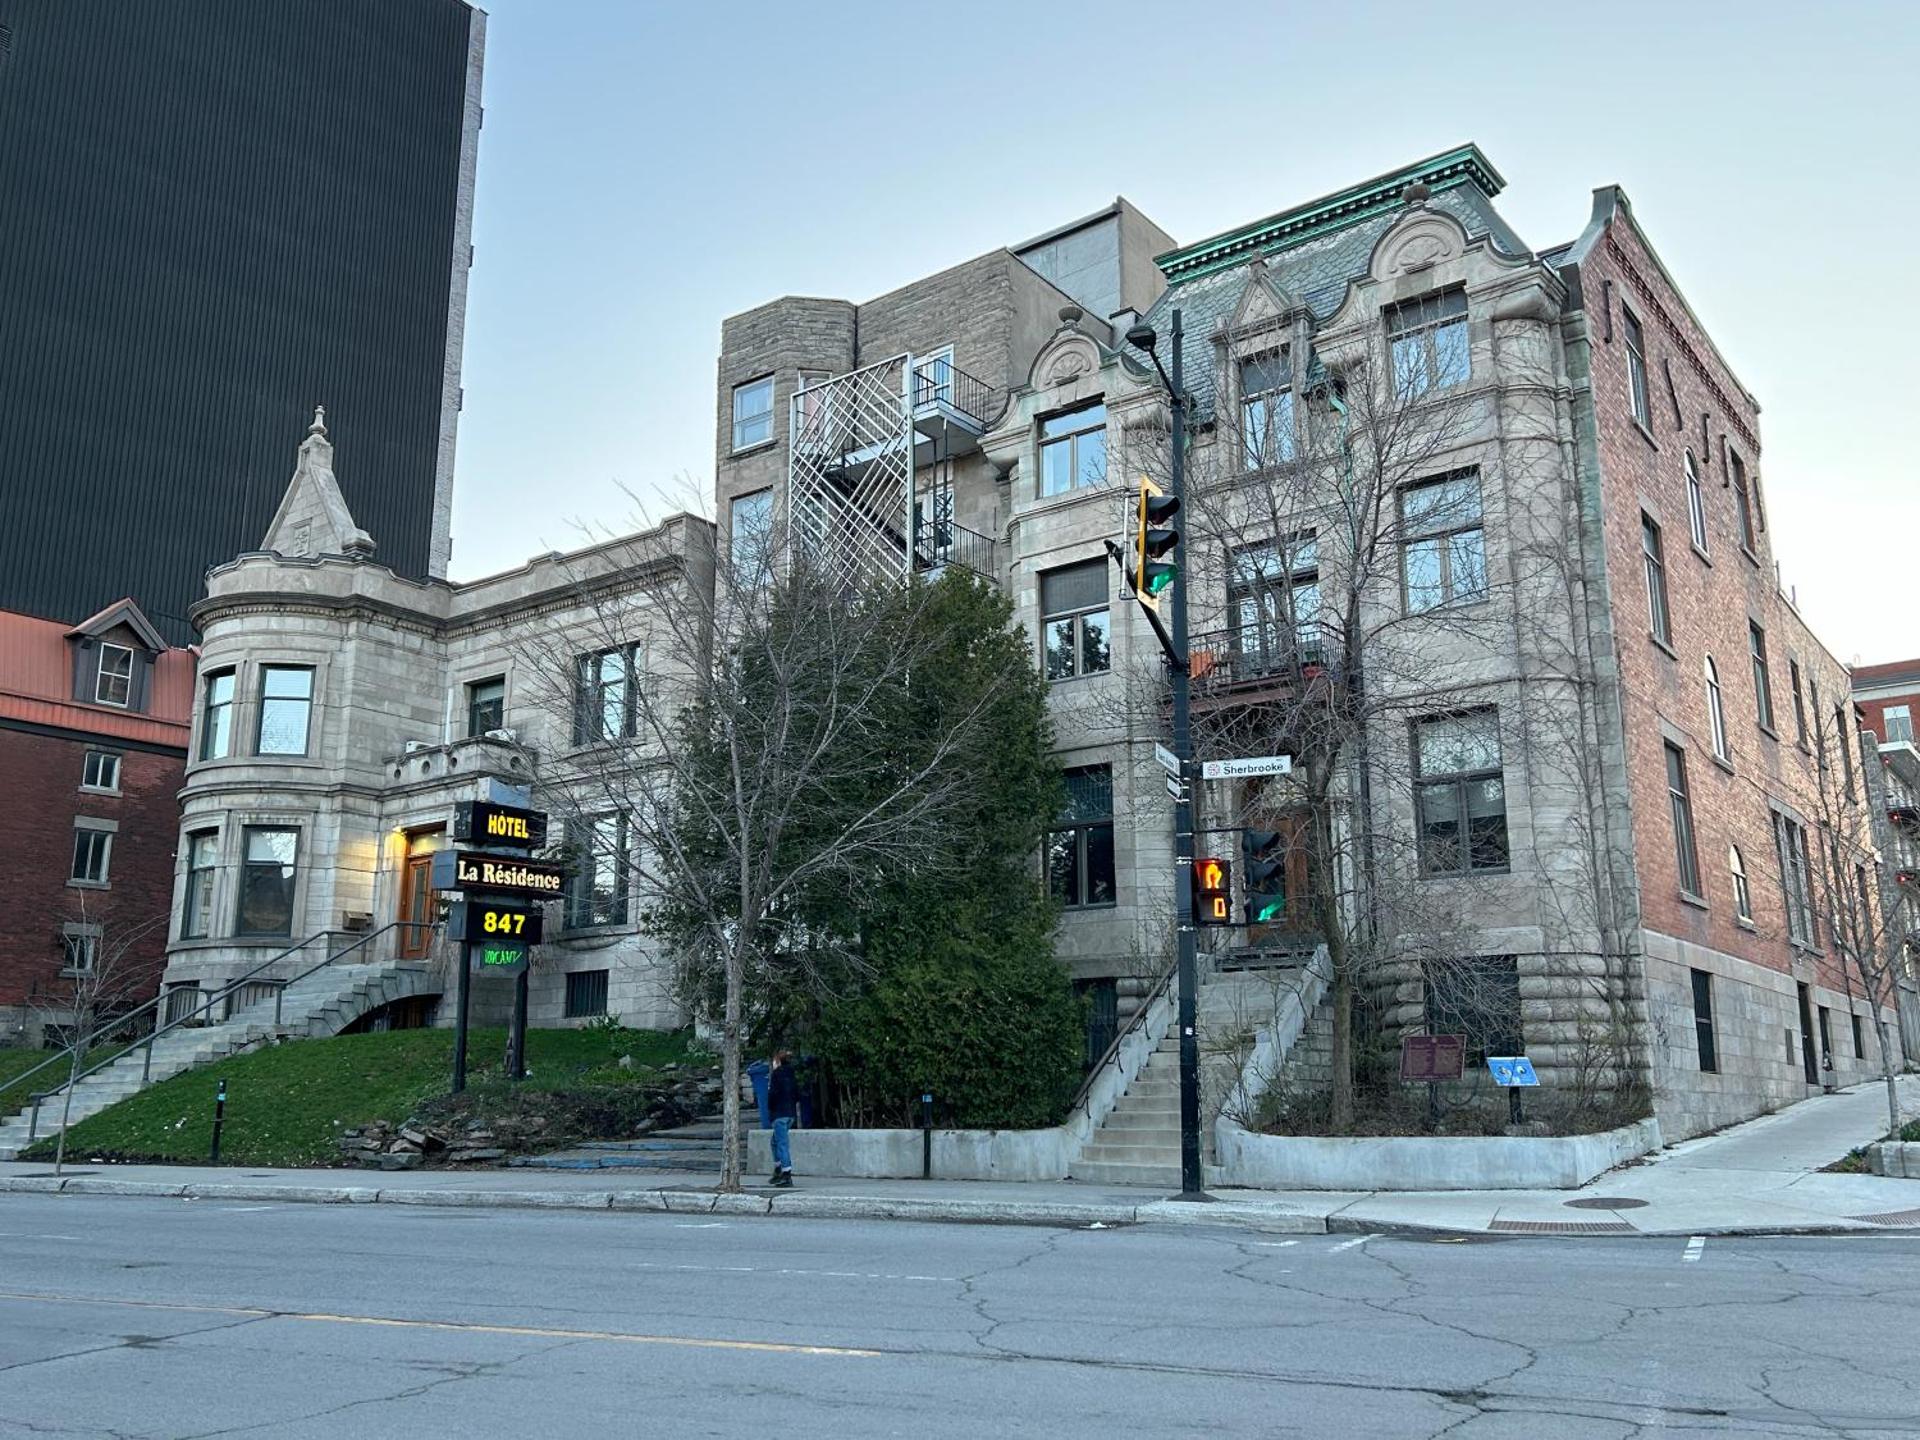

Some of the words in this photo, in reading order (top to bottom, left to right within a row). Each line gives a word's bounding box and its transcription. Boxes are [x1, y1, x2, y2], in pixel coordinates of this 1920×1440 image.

[1223, 763, 1284, 775] Sherbrooke
[487, 810, 529, 839] HÔTEL
[457, 860, 478, 881] La
[482, 863, 560, 890] Résidence
[483, 911, 526, 934] 847
